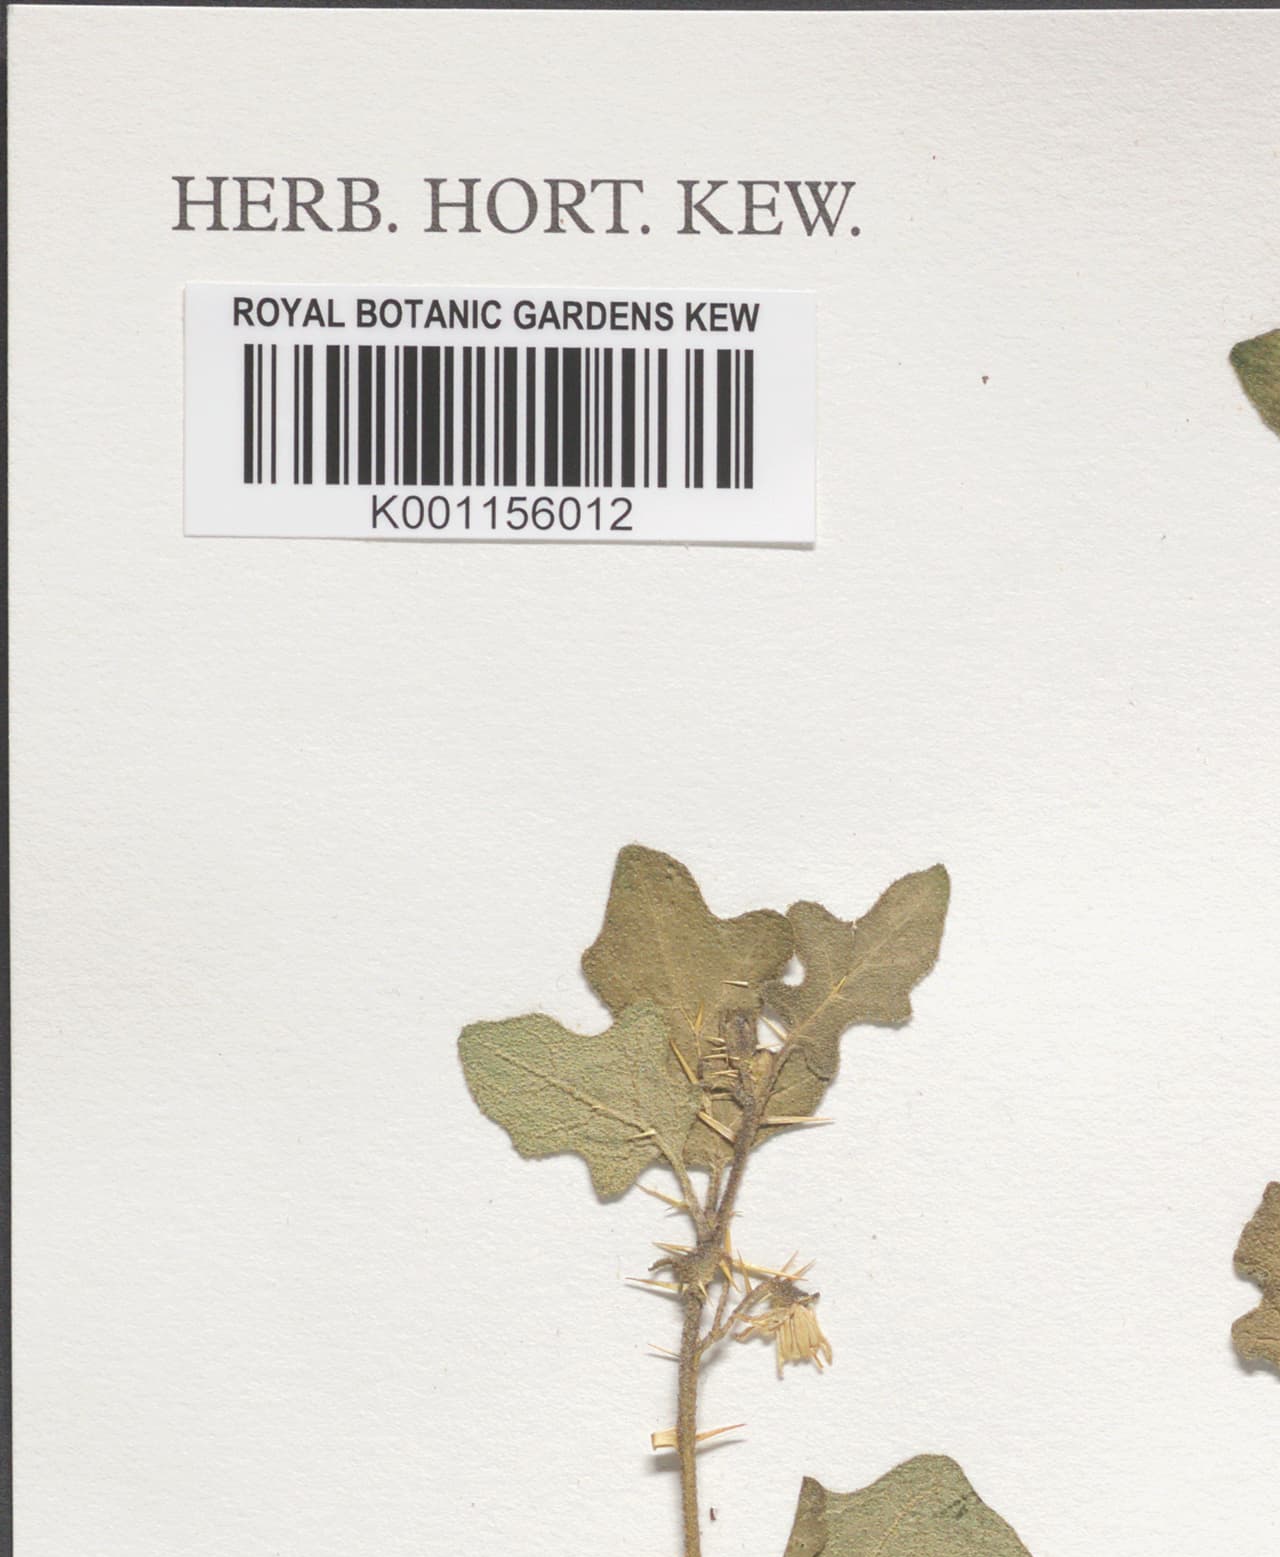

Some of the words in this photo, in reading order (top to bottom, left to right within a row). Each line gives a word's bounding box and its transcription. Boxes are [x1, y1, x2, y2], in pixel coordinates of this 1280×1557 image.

[171, 175, 398, 234] HERB.
[423, 177, 651, 235] HORT.
[676, 179, 861, 238] KEW.
[232, 296, 346, 328] ROYAL
[356, 298, 502, 330] BOTANIC
[513, 299, 675, 332] GARDENS
[685, 301, 761, 333] KEW
[371, 494, 633, 532] K001156012
